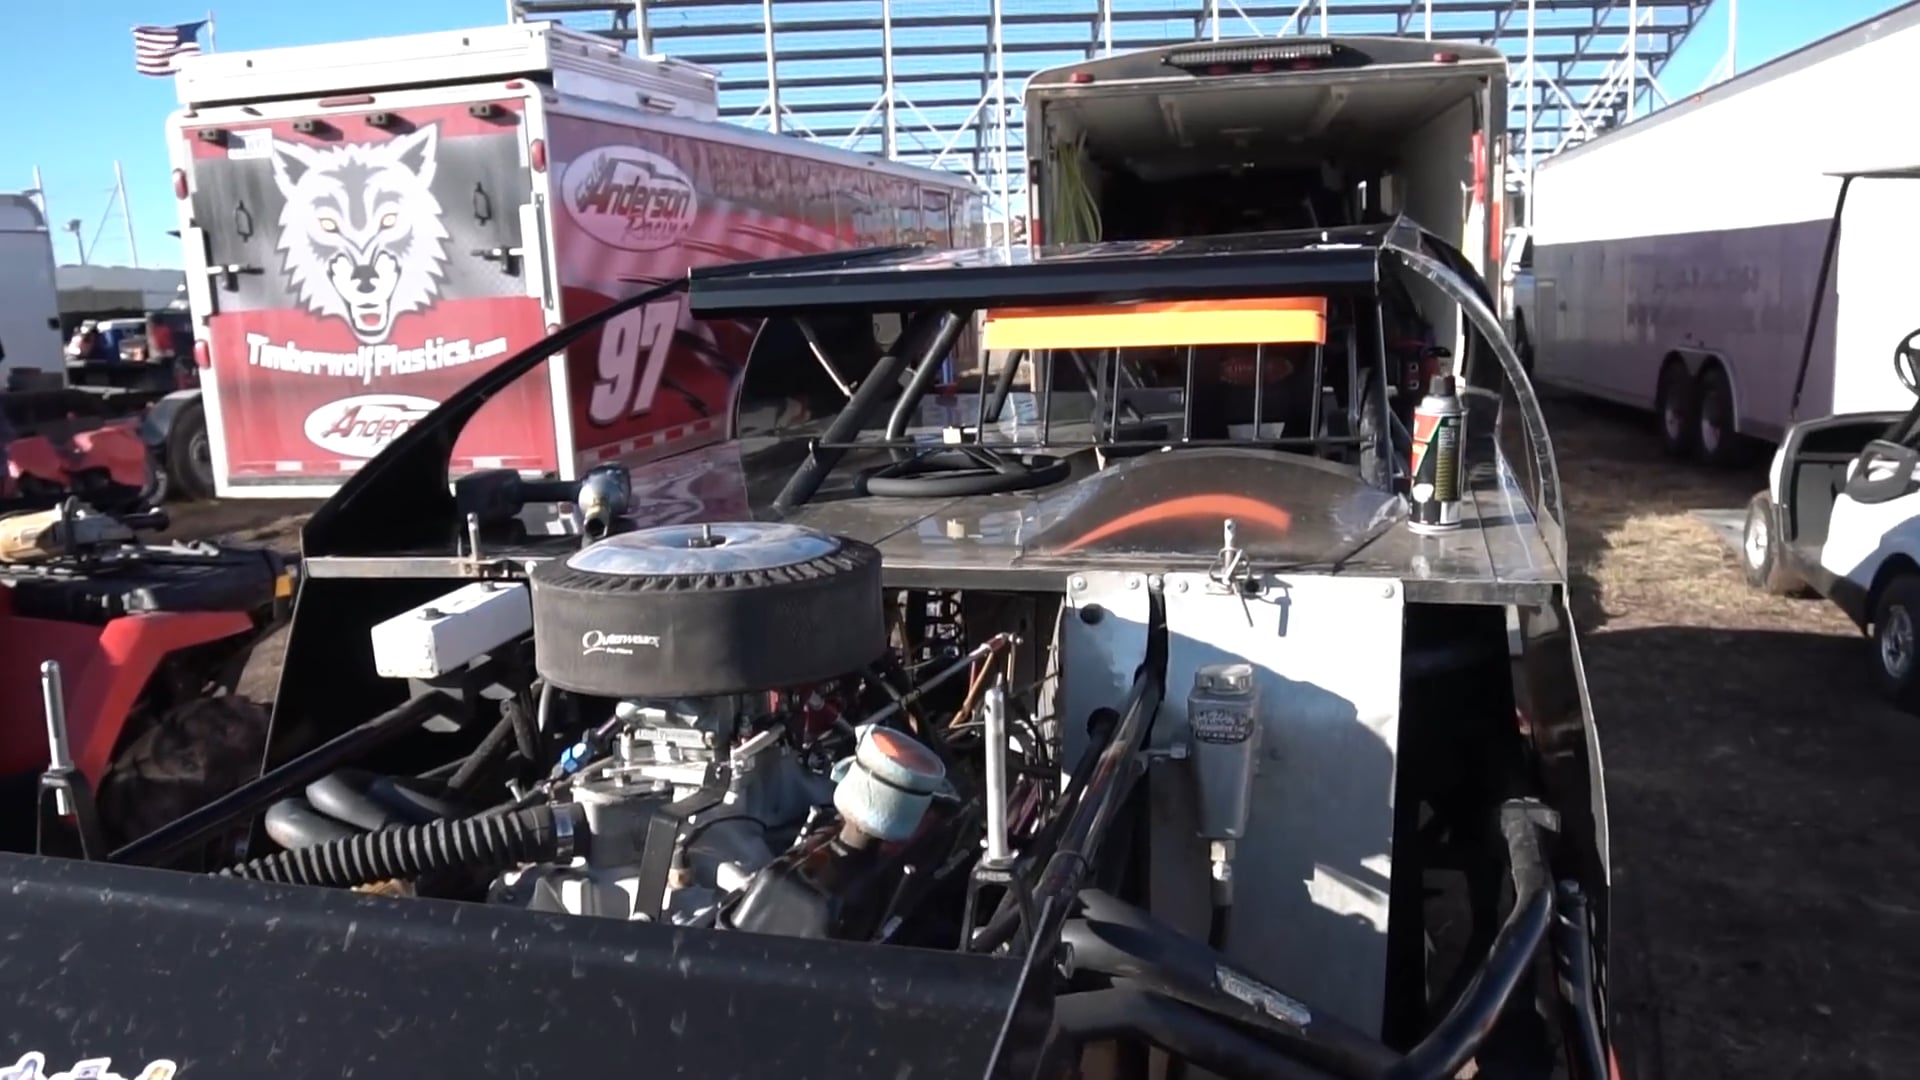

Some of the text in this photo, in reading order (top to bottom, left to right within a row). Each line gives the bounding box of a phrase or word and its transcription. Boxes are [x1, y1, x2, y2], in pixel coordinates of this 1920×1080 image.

[579, 159, 691, 219] Anderson
[246, 333, 507, 385] TimberwolfPlastics.com
[589, 300, 679, 420] 97
